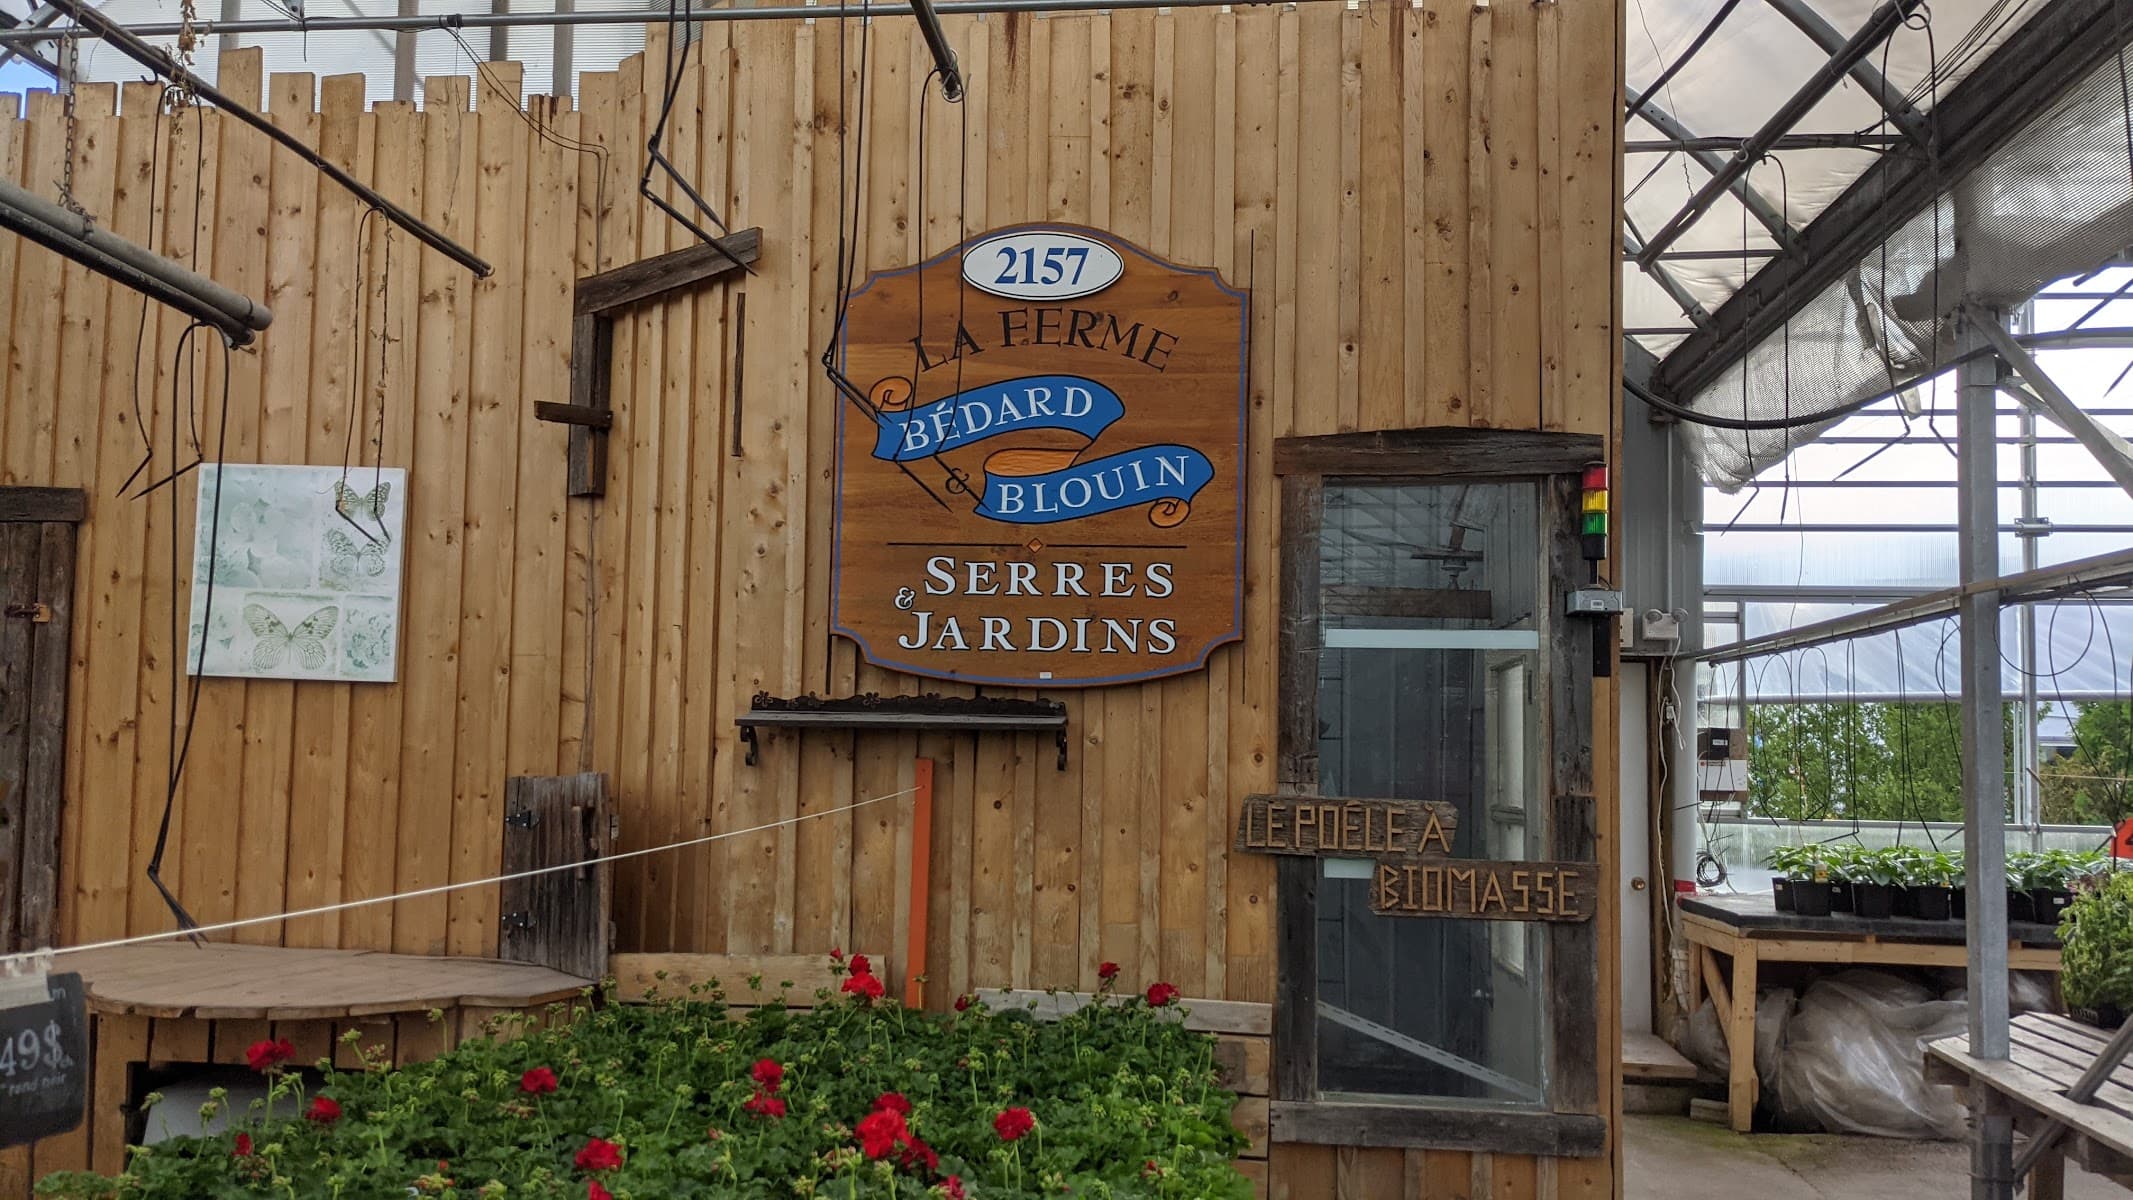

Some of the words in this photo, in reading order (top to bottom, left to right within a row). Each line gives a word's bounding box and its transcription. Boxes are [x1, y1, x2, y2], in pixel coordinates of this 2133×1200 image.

[994, 247, 1090, 285] 2157
[908, 320, 985, 373] LA
[997, 307, 1180, 373] FERME
[897, 385, 1094, 452] BÉDARD
[996, 455, 1190, 514] BLOUIN
[894, 586, 916, 610] &
[923, 555, 1175, 599] SERRES
[897, 610, 1177, 655] JARDINS
[1246, 804, 1288, 849] LE
[1417, 803, 1451, 853] À
[1379, 864, 1580, 917] BIOMASSE
